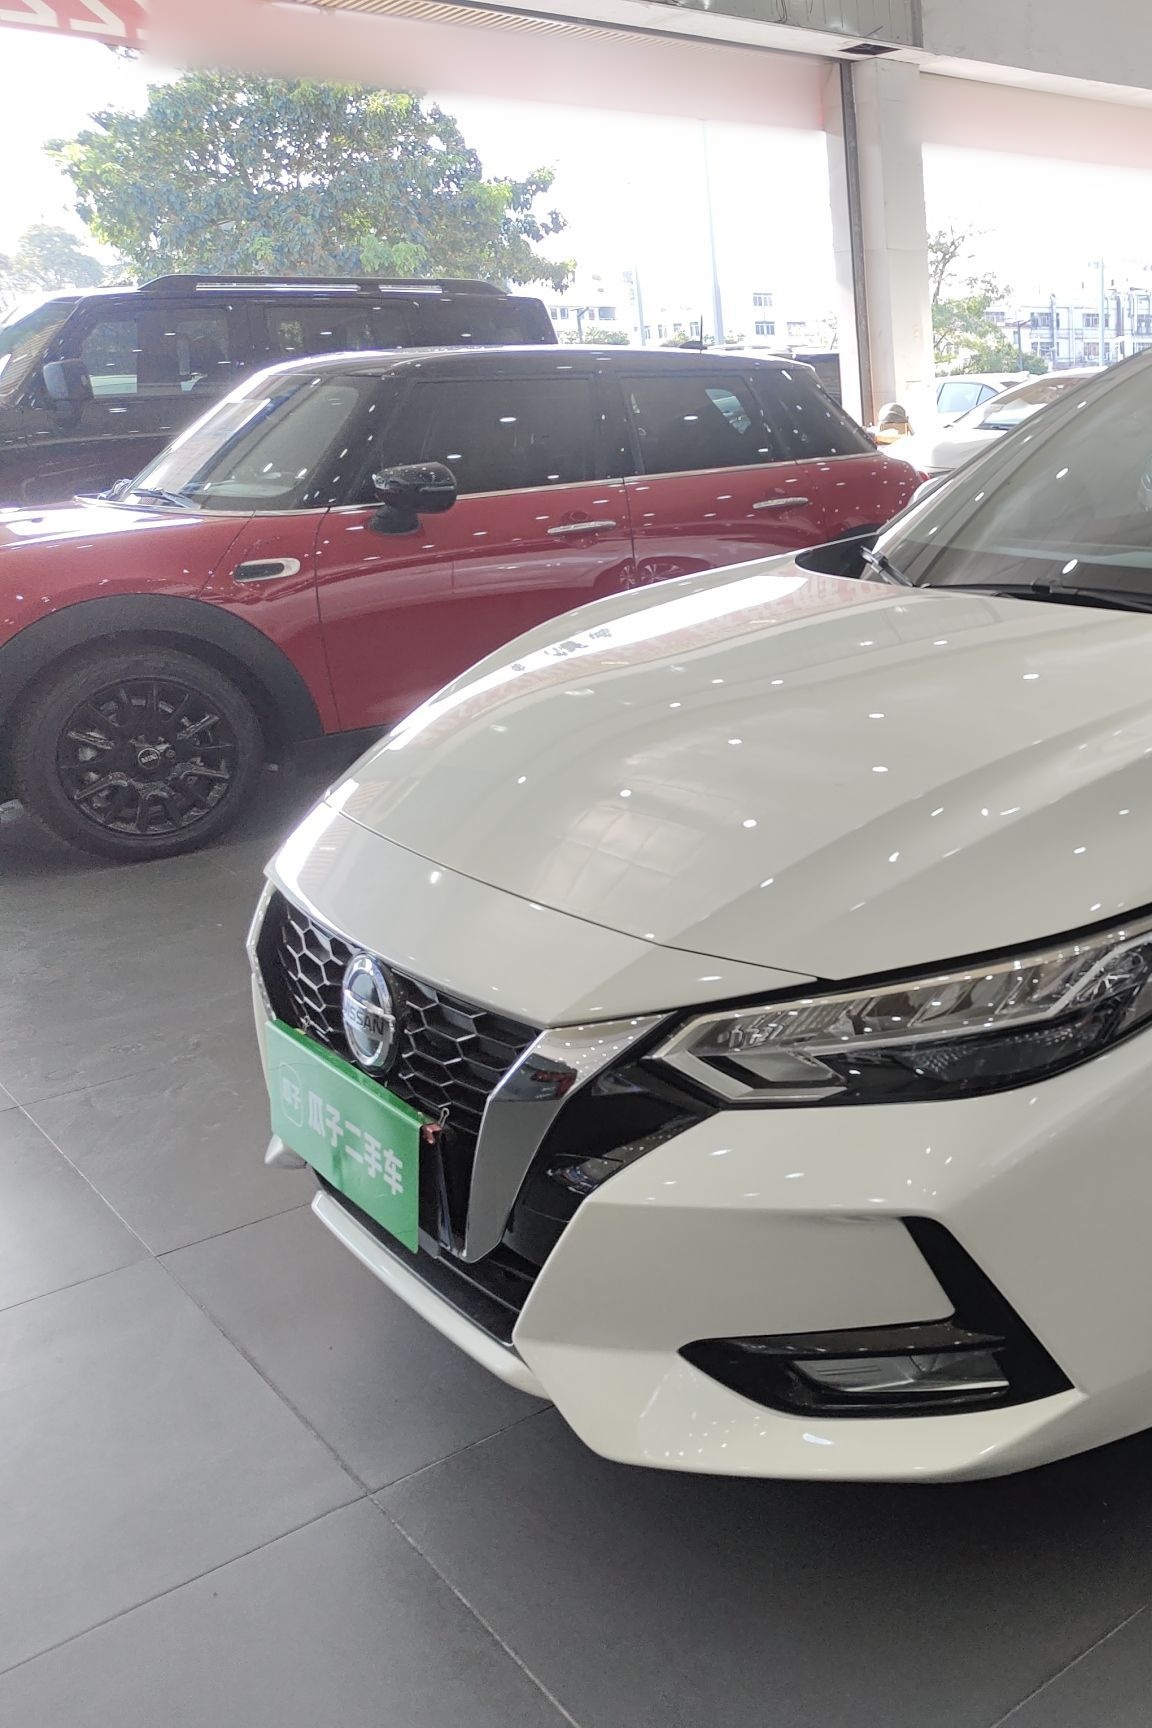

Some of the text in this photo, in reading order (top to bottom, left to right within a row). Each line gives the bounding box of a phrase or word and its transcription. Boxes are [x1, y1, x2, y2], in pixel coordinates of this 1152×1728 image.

[308, 1090, 404, 1196] 瓜子二手车
